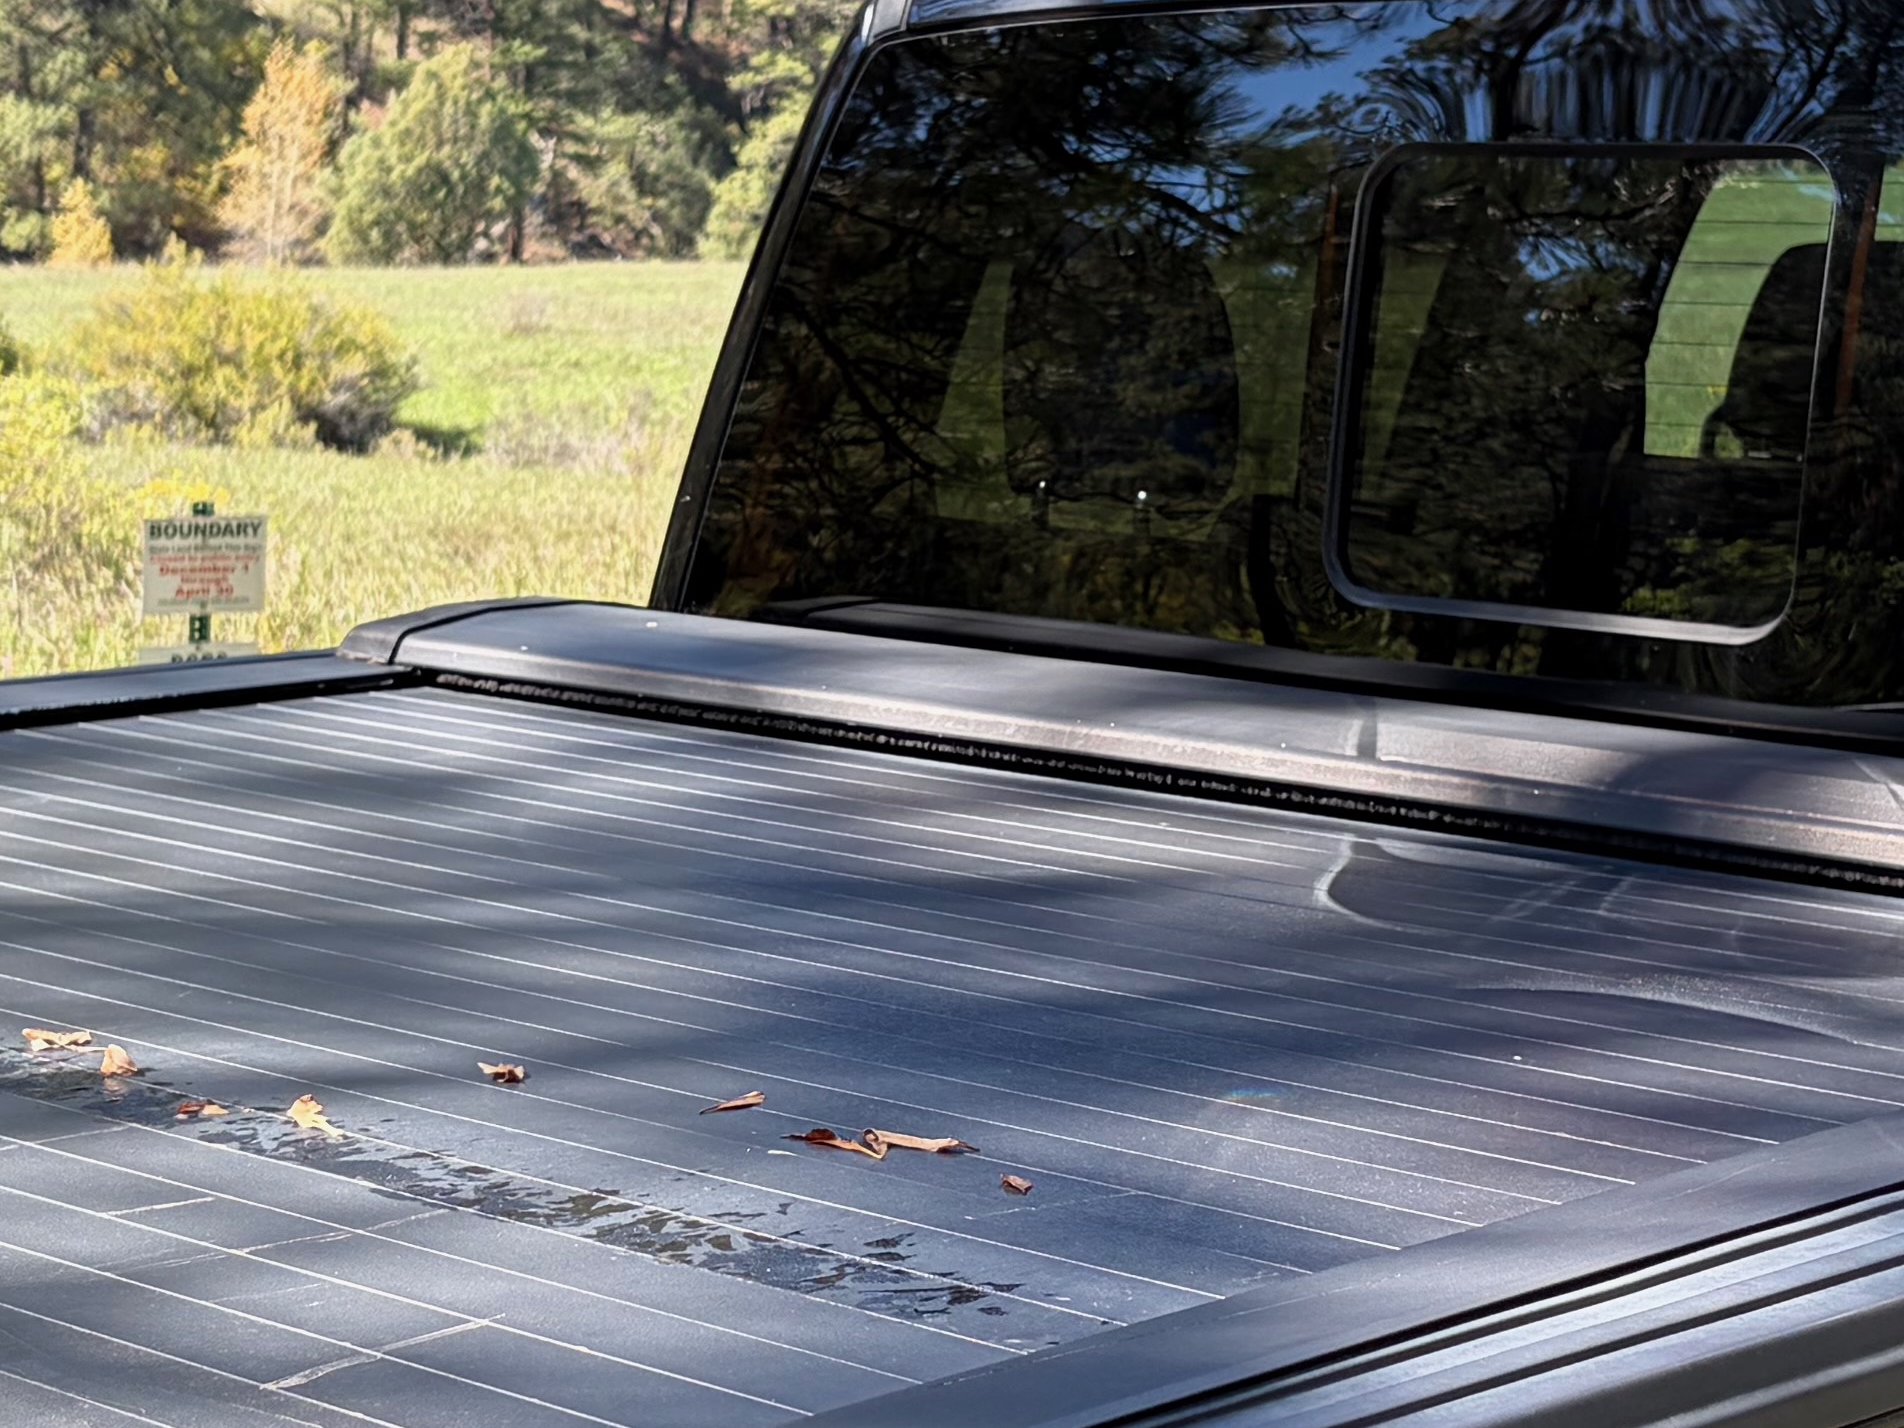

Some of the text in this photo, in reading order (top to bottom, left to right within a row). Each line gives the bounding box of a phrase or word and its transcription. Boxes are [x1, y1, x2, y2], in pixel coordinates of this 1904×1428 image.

[149, 521, 263, 540] BOUNDARY
[159, 563, 235, 576] December
[176, 585, 210, 600] April
